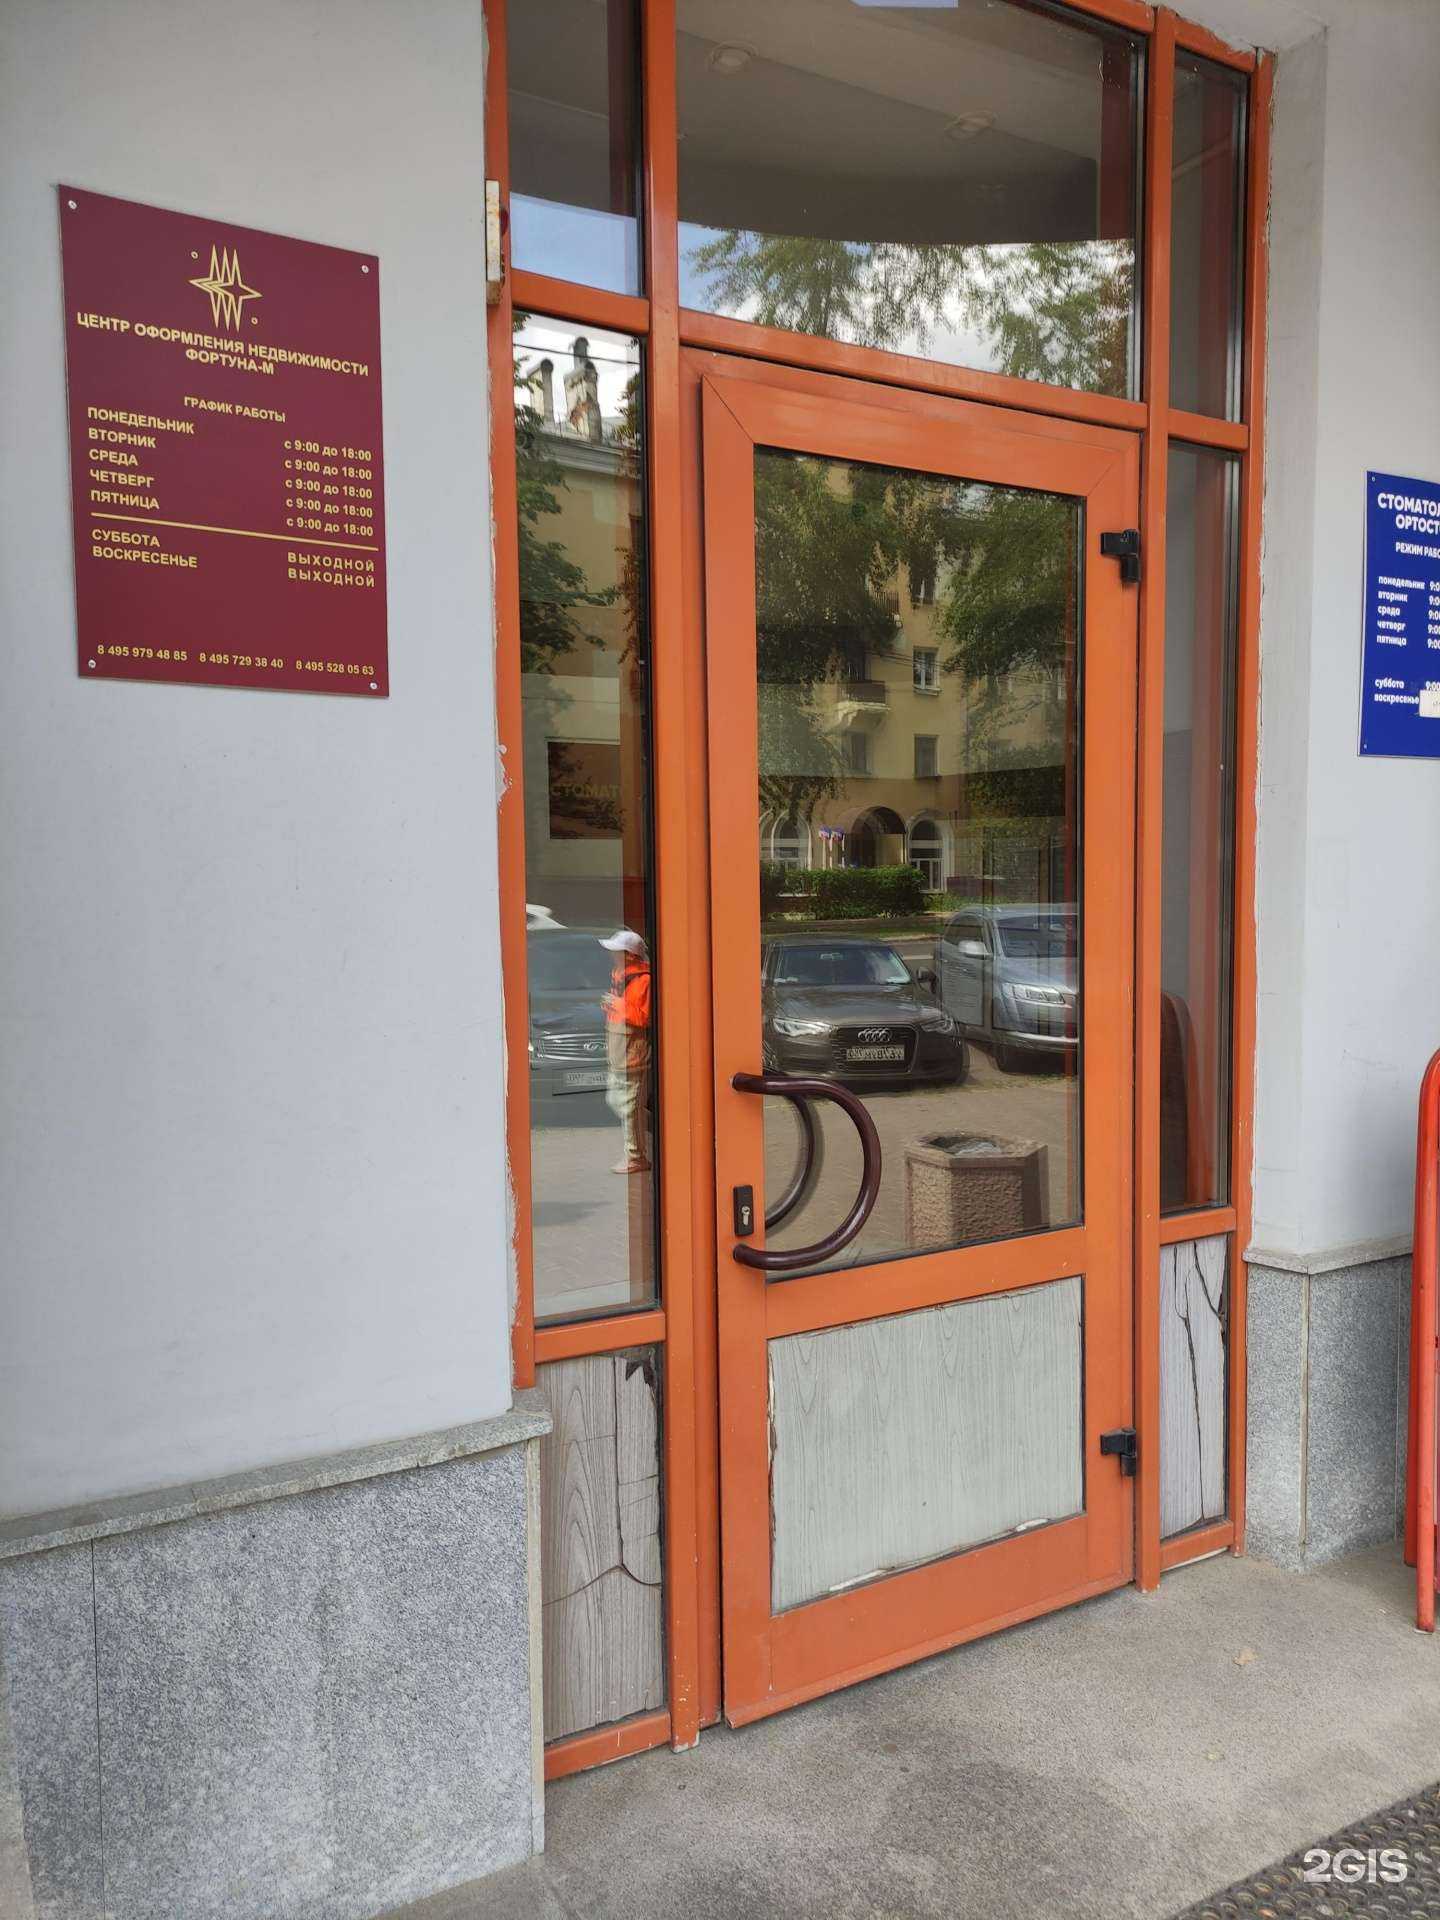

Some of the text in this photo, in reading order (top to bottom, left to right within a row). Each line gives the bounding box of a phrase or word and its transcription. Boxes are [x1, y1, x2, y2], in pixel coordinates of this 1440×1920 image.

[77, 311, 369, 376] ЦЕНТР ОФОРМЛЕНИЯ НЕДВИЖИМОСТИ
[185, 348, 274, 375] ФОРТУНА-М
[184, 396, 286, 423] ГРАФИК РАБОТЫ
[87, 407, 371, 462] ПОНЕДЕЛЬНИК с 9:00 до 18:00
[88, 428, 372, 480] ВТОРНИК с 9:00 до 18:00
[89, 449, 372, 499] СРЕДА с 9:00 до 18:00
[90, 469, 373, 518] ЧЕТВЕРГ с 9:00 до 18:00
[90, 490, 374, 537] ПЯТНИЦА с 9:00 до 18:00
[1395, 514, 1440, 535] ОРТОСТ
[92, 528, 375, 572] СУББОТА ВЫХОДНОЙ
[1395, 541, 1423, 556] РЕЖИМ
[92, 546, 375, 587] ВОСКРЕСЕНЬЕ ВЫХОДНОЙ
[1378, 575, 1425, 590] понедельник
[1378, 590, 1408, 602] вторник
[1377, 605, 1400, 616] среда
[1377, 620, 1406, 632] четверг
[1376, 634, 1407, 647] пятница
[97, 644, 188, 661] 8 495 979 48 85
[199, 652, 207, 663] 8
[209, 653, 230, 664] 495
[232, 655, 252, 666] 729
[270, 658, 283, 669] 40
[305, 661, 324, 672] 495
[327, 662, 345, 673] 528
[347, 664, 360, 674] 05
[1375, 677, 1405, 689] суббота
[1374, 693, 1419, 705] воскресенье
